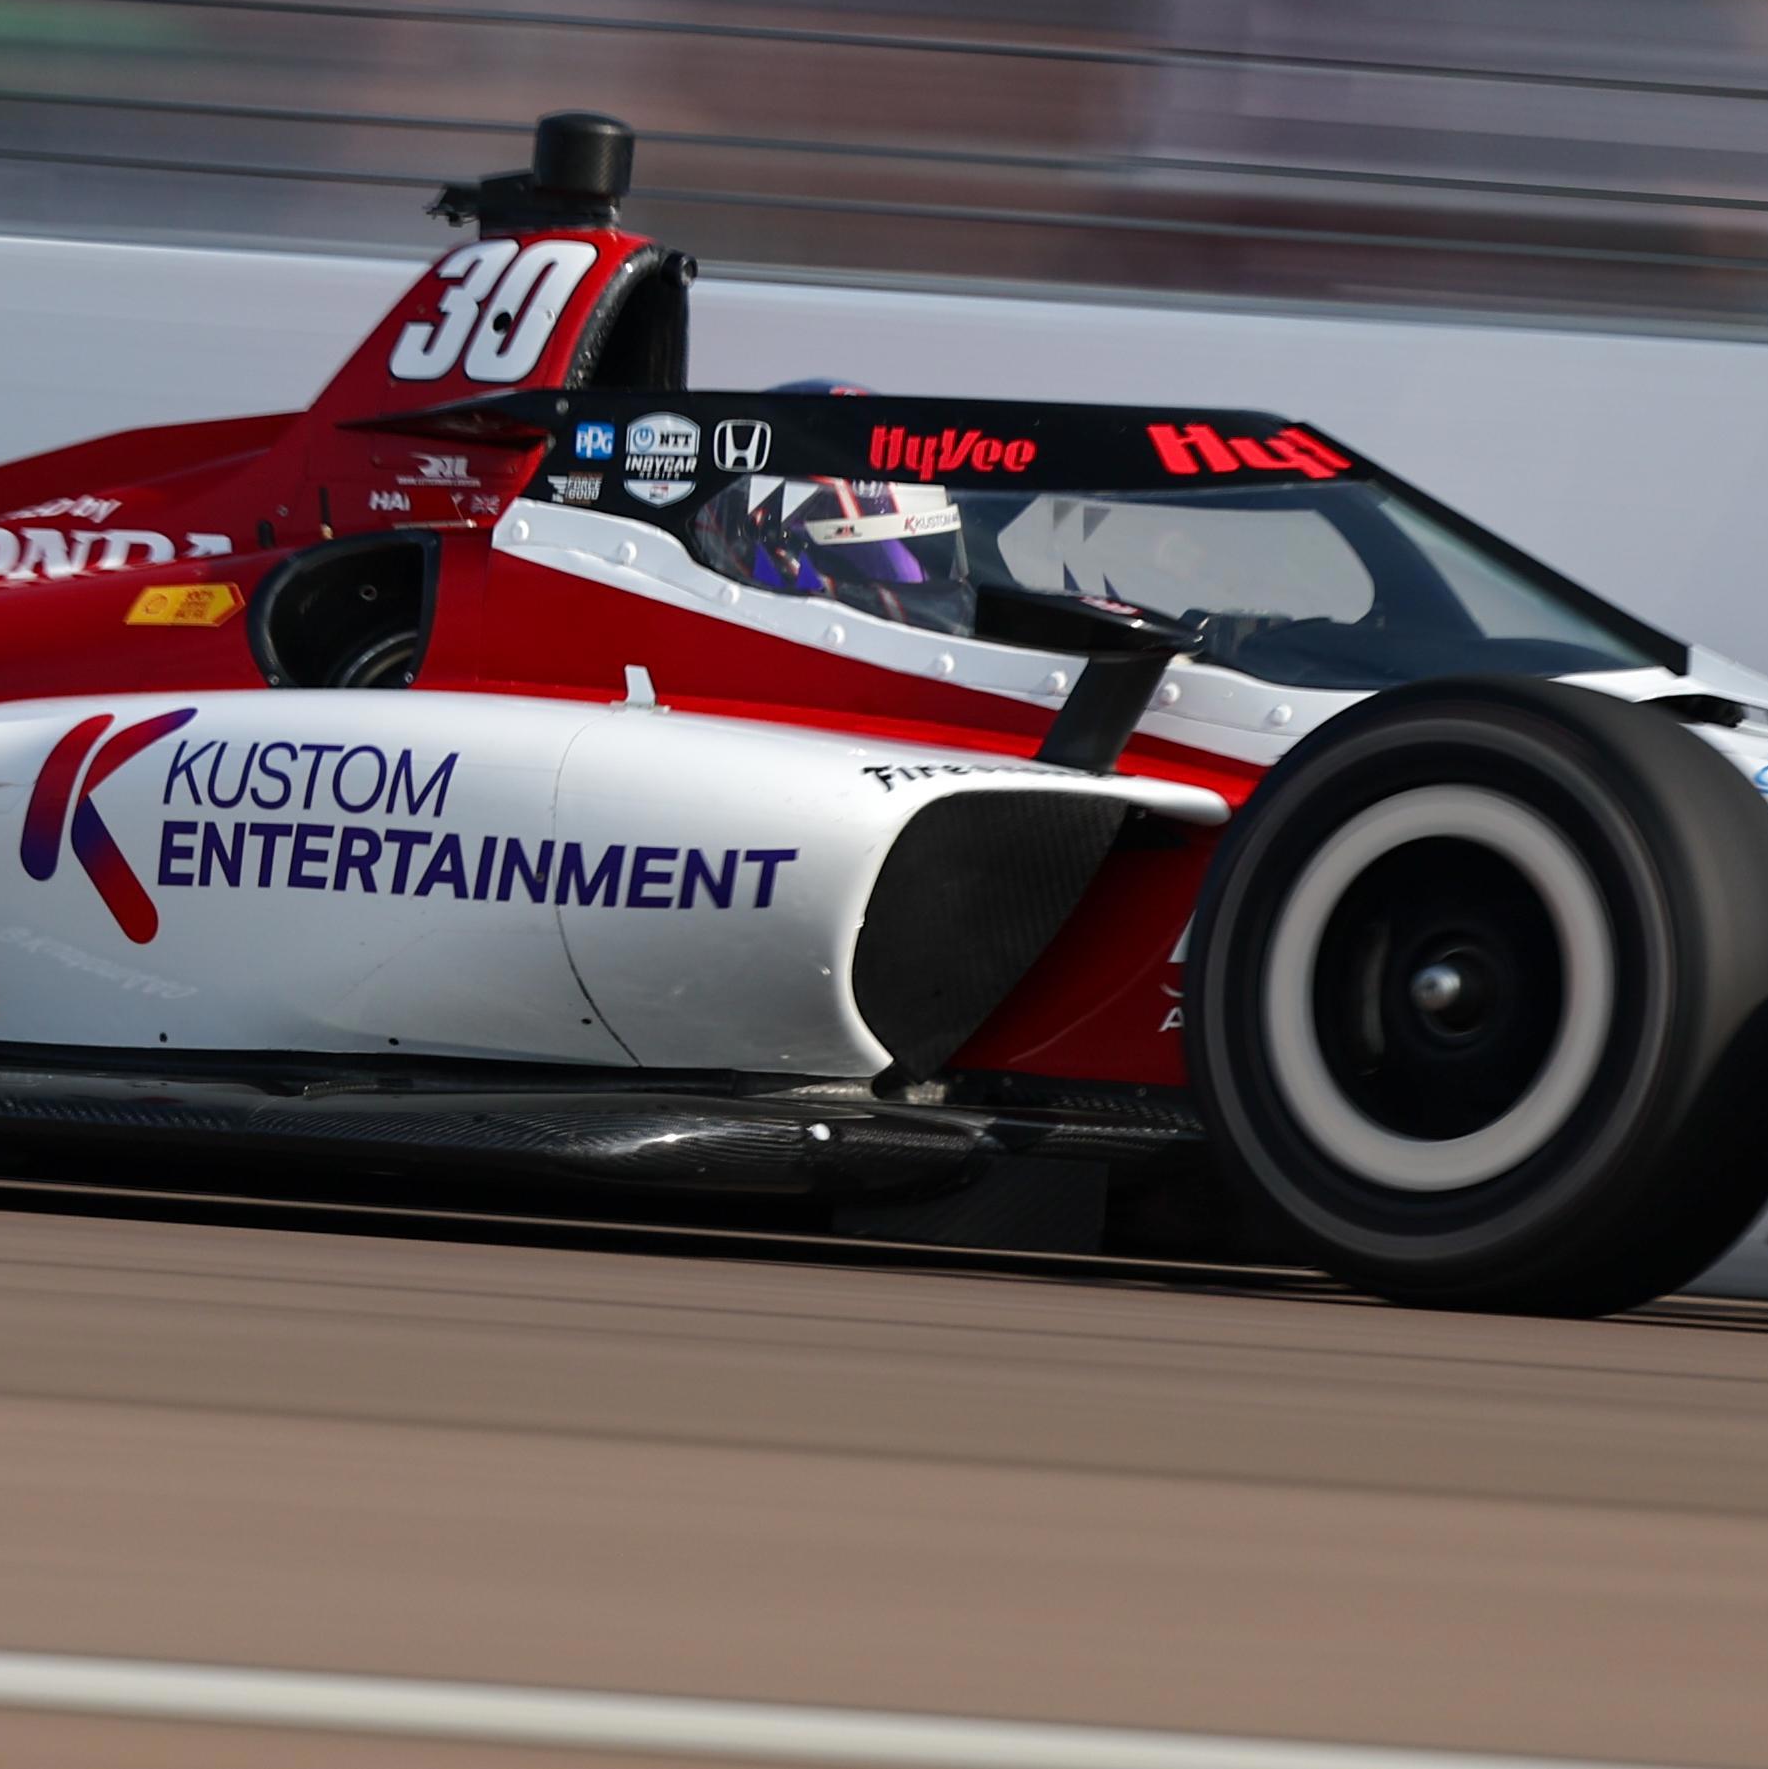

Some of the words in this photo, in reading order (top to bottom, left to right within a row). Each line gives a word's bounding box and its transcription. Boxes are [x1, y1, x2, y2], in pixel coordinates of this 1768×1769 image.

[390, 239, 598, 382] 30
[625, 456, 698, 473] INDYCAR
[659, 433, 692, 447] NTT
[162, 739, 461, 818] KUSTOM
[157, 820, 799, 911] ENTERTAINMENT
